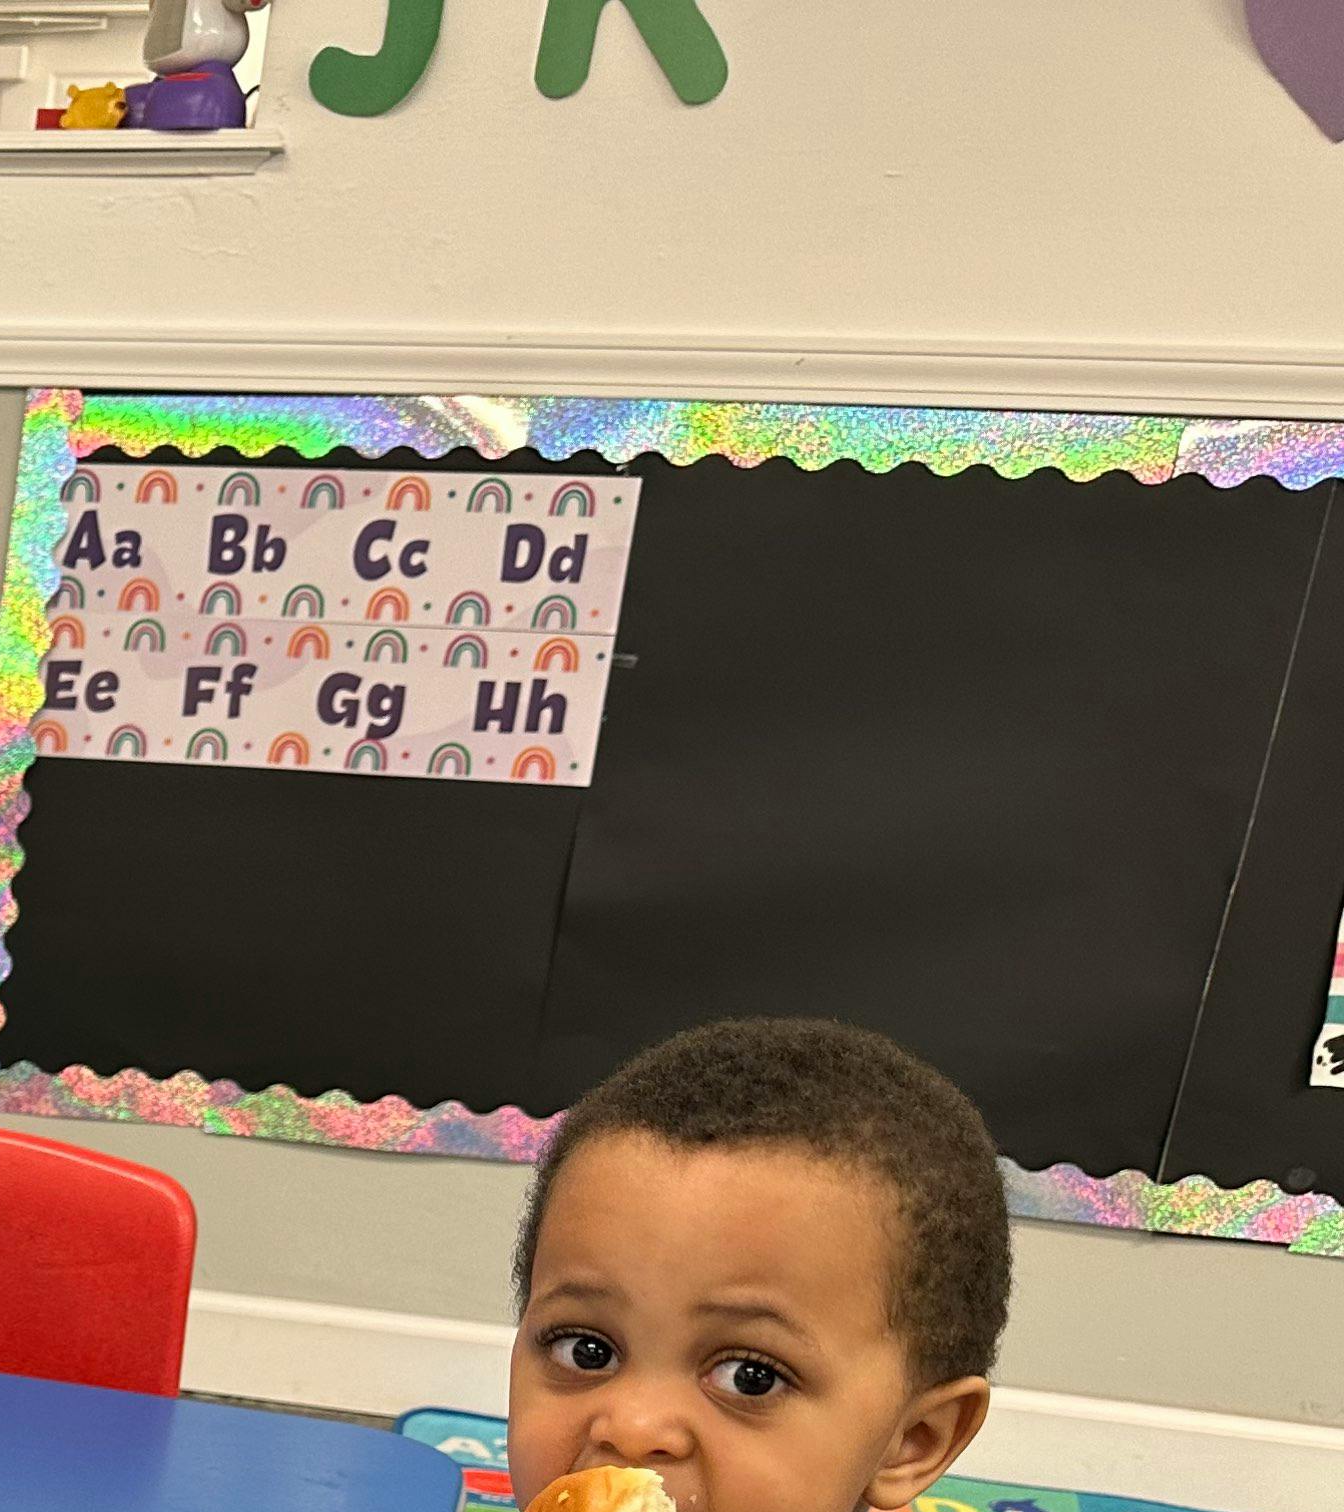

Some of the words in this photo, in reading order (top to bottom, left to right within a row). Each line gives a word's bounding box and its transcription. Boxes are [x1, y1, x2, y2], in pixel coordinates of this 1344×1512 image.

[63, 509, 143, 571] Aa
[208, 513, 288, 575] Bb
[353, 518, 431, 581] Cc
[501, 523, 589, 584] Dd
[45, 659, 120, 713] Ee
[182, 662, 258, 719] Ff
[317, 672, 407, 741] Gg
[473, 679, 569, 735] Hh
